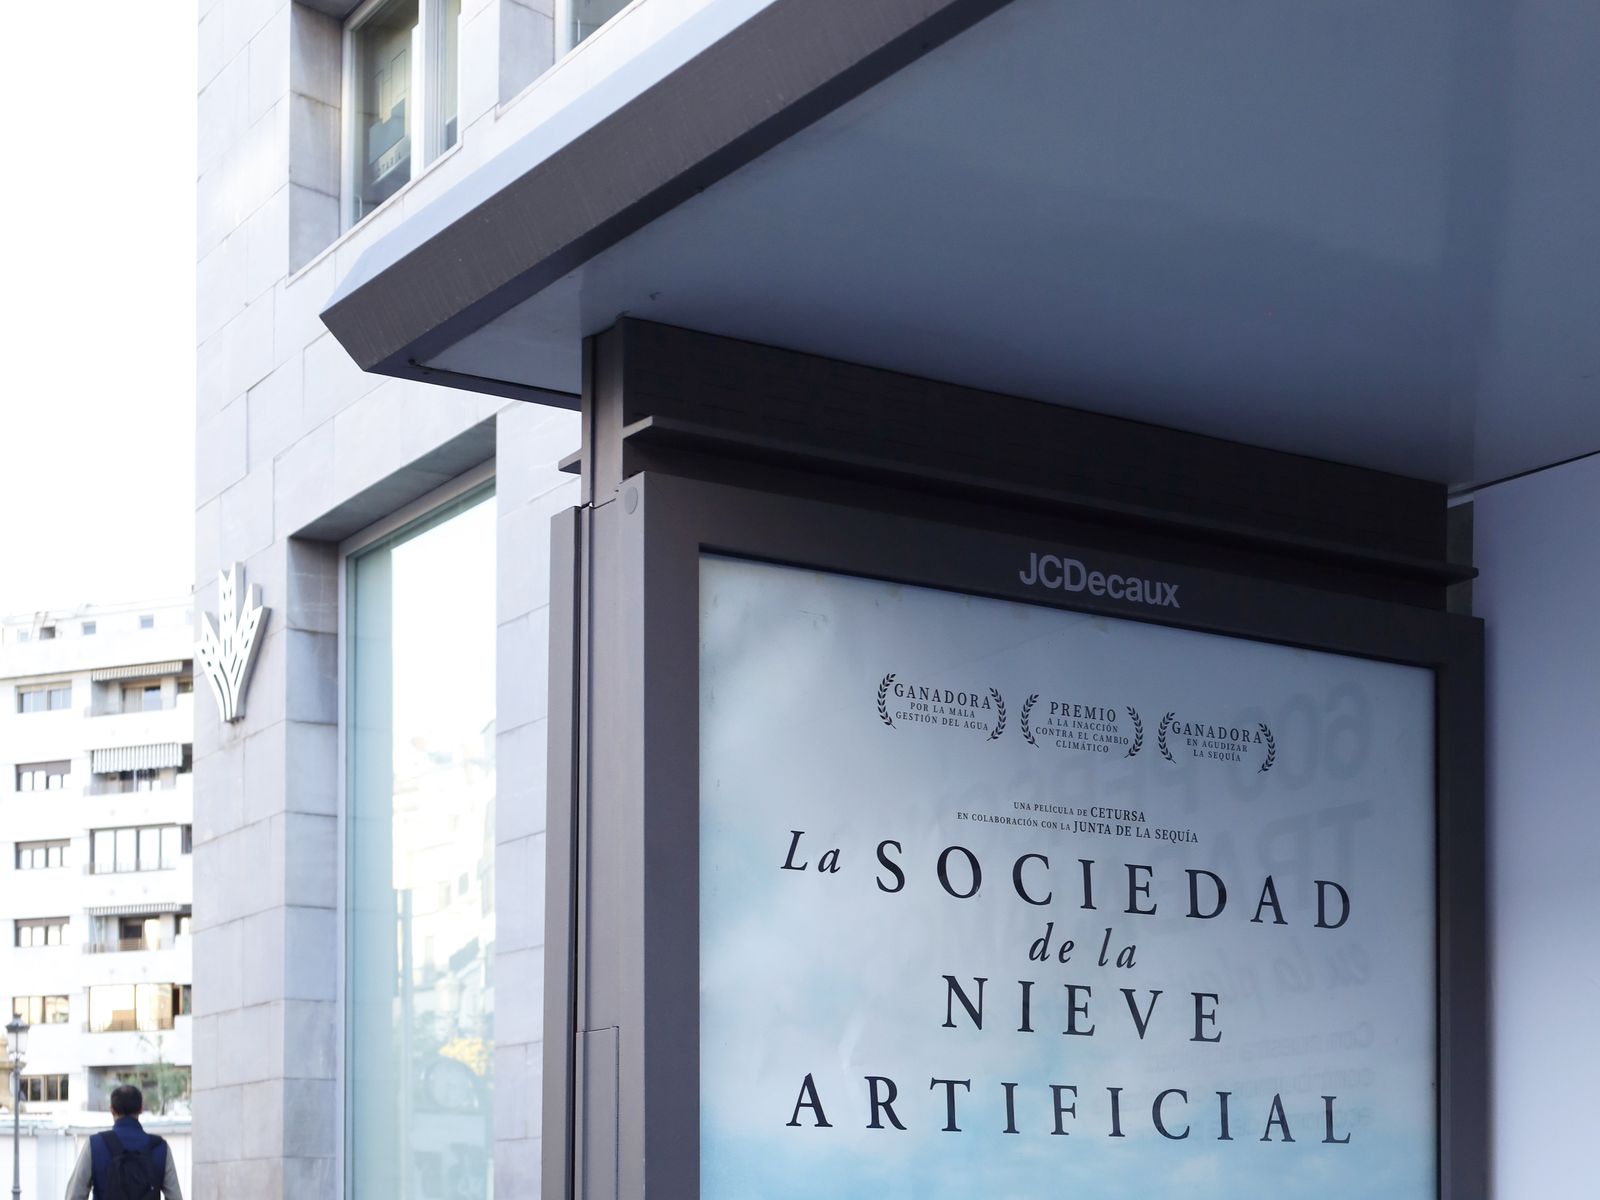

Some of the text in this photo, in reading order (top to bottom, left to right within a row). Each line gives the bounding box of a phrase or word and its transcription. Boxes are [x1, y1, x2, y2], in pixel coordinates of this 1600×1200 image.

[1019, 552, 1181, 608] JCDecaux
[894, 683, 991, 710] GANADORA
[910, 702, 975, 718] POR LA MALA
[1050, 701, 1116, 722] PREMIO
[895, 711, 988, 731] GESTIÓN DEL AGUA
[1047, 717, 1118, 733] A LA INACCIÓN
[1035, 727, 1129, 745] CONTRA EL CAMBIO
[1172, 721, 1262, 744] GANADORA
[1056, 740, 1109, 753] CLIMÁTICO
[1186, 738, 1248, 752] EN AGUDIZAR
[1193, 749, 1241, 762] LA SEQUÍA
[1013, 801, 1146, 822] UNA PELÍCULA DE CETURSA
[957, 812, 1199, 844] EN COLABORACIÓN CON LA JUNTA DE LA SEQUÍA
[781, 829, 841, 874] La
[876, 839, 1351, 929] SOCIEDAD
[1028, 922, 1137, 969] de la
[941, 974, 1222, 1043] NIEVE
[785, 1072, 1352, 1145] ARTIFICIAL
